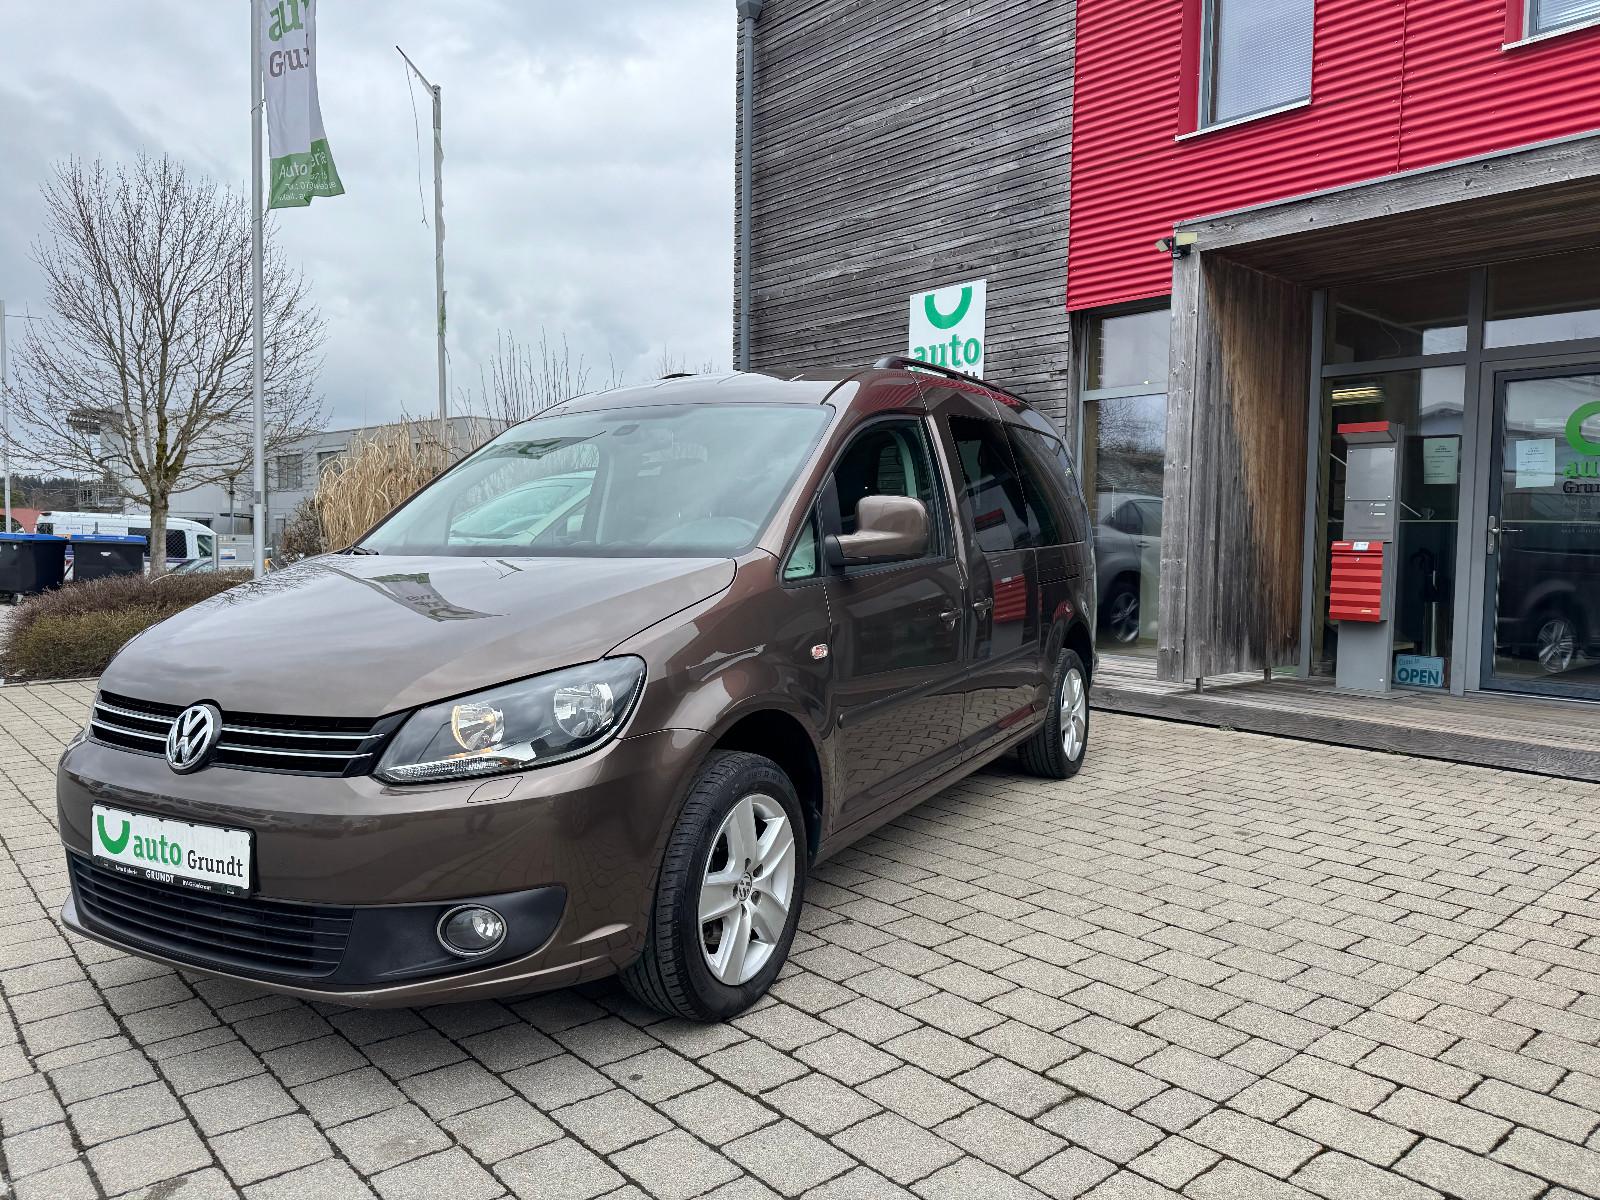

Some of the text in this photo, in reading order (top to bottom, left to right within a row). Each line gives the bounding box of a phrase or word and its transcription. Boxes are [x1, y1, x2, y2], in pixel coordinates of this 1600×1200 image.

[269, 0, 309, 41] au
[278, 162, 308, 180] Auto
[913, 334, 981, 368] auto
[1397, 667, 1440, 685] OPEN
[133, 834, 244, 878] auto Grundt
[145, 869, 175, 884] GRUNDT
